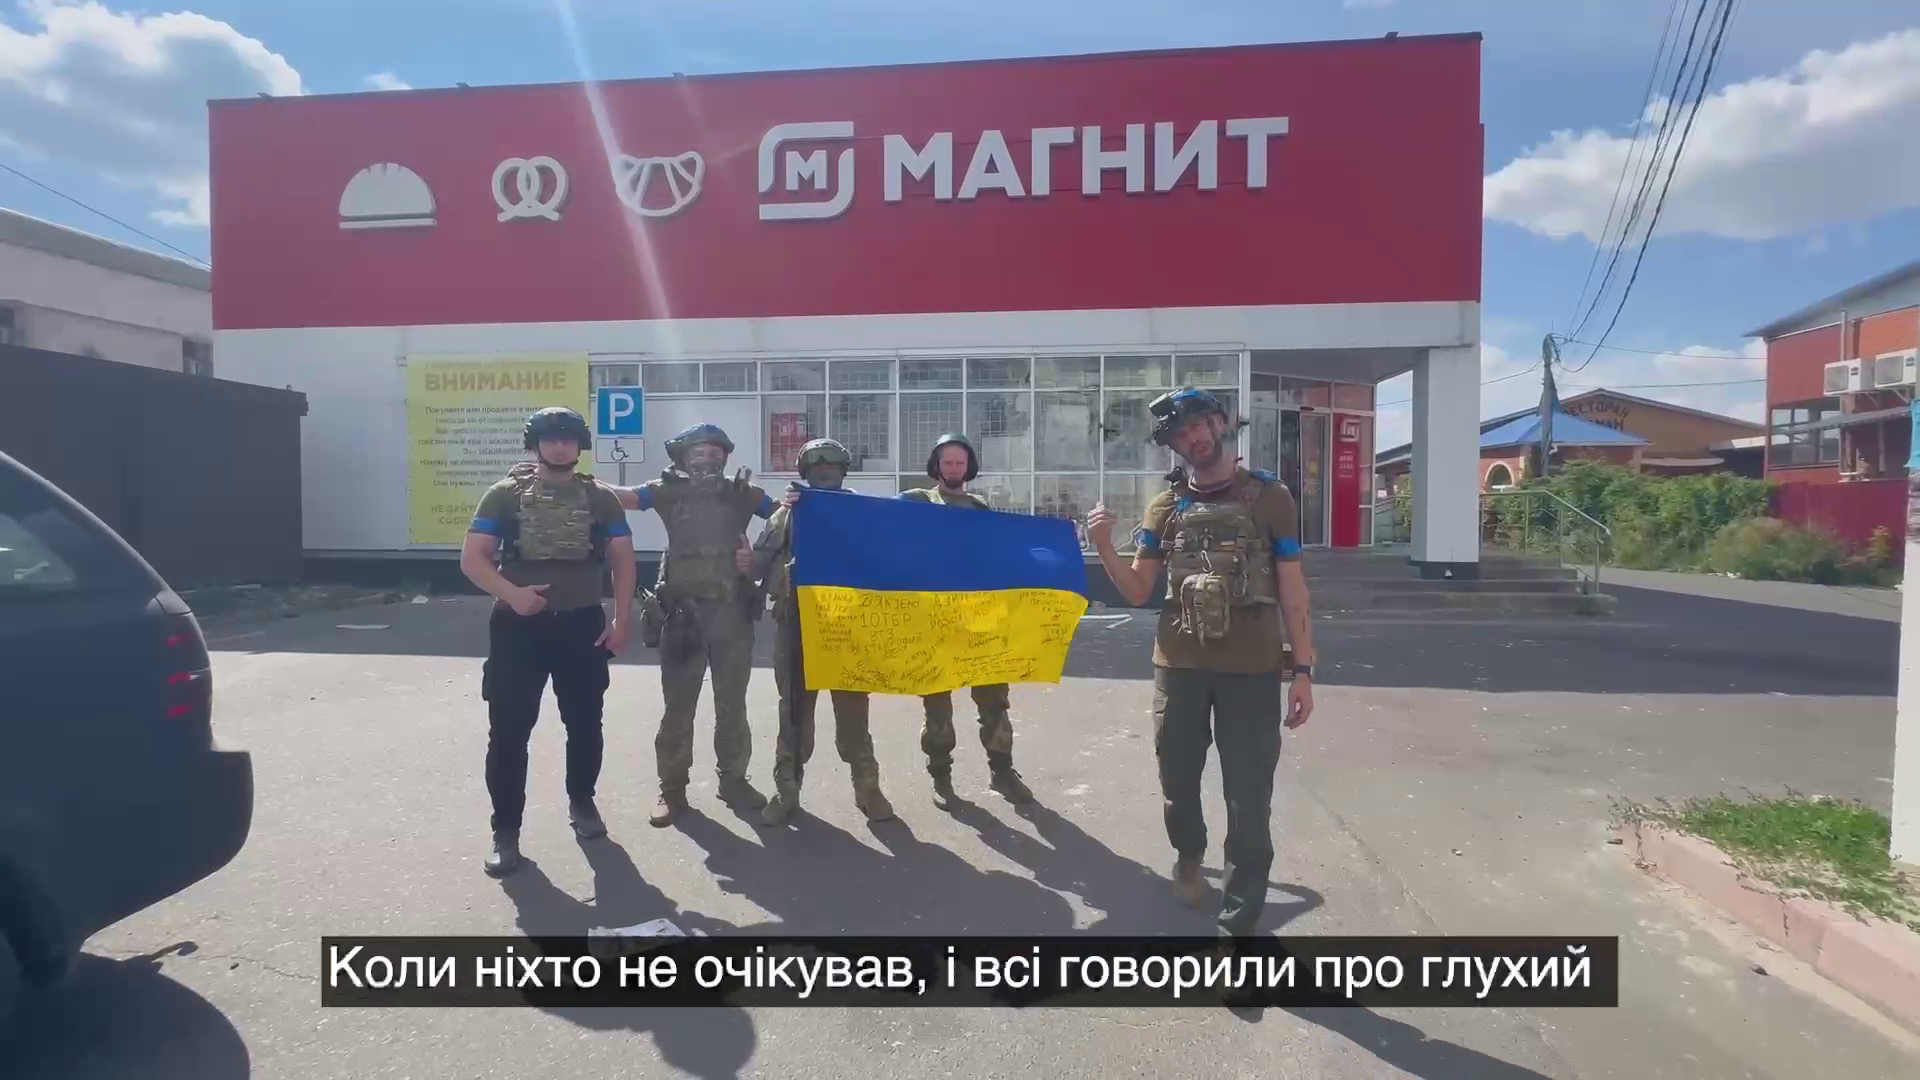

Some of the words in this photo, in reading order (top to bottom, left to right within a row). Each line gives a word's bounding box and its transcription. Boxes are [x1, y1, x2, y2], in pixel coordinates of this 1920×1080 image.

[786, 149, 827, 191] М
[883, 116, 1289, 201] МАГНИТ
[424, 371, 566, 392] ВНИМАНИЕ
[609, 393, 634, 431] P
[1563, 401, 1631, 418] ЕСТОРАН
